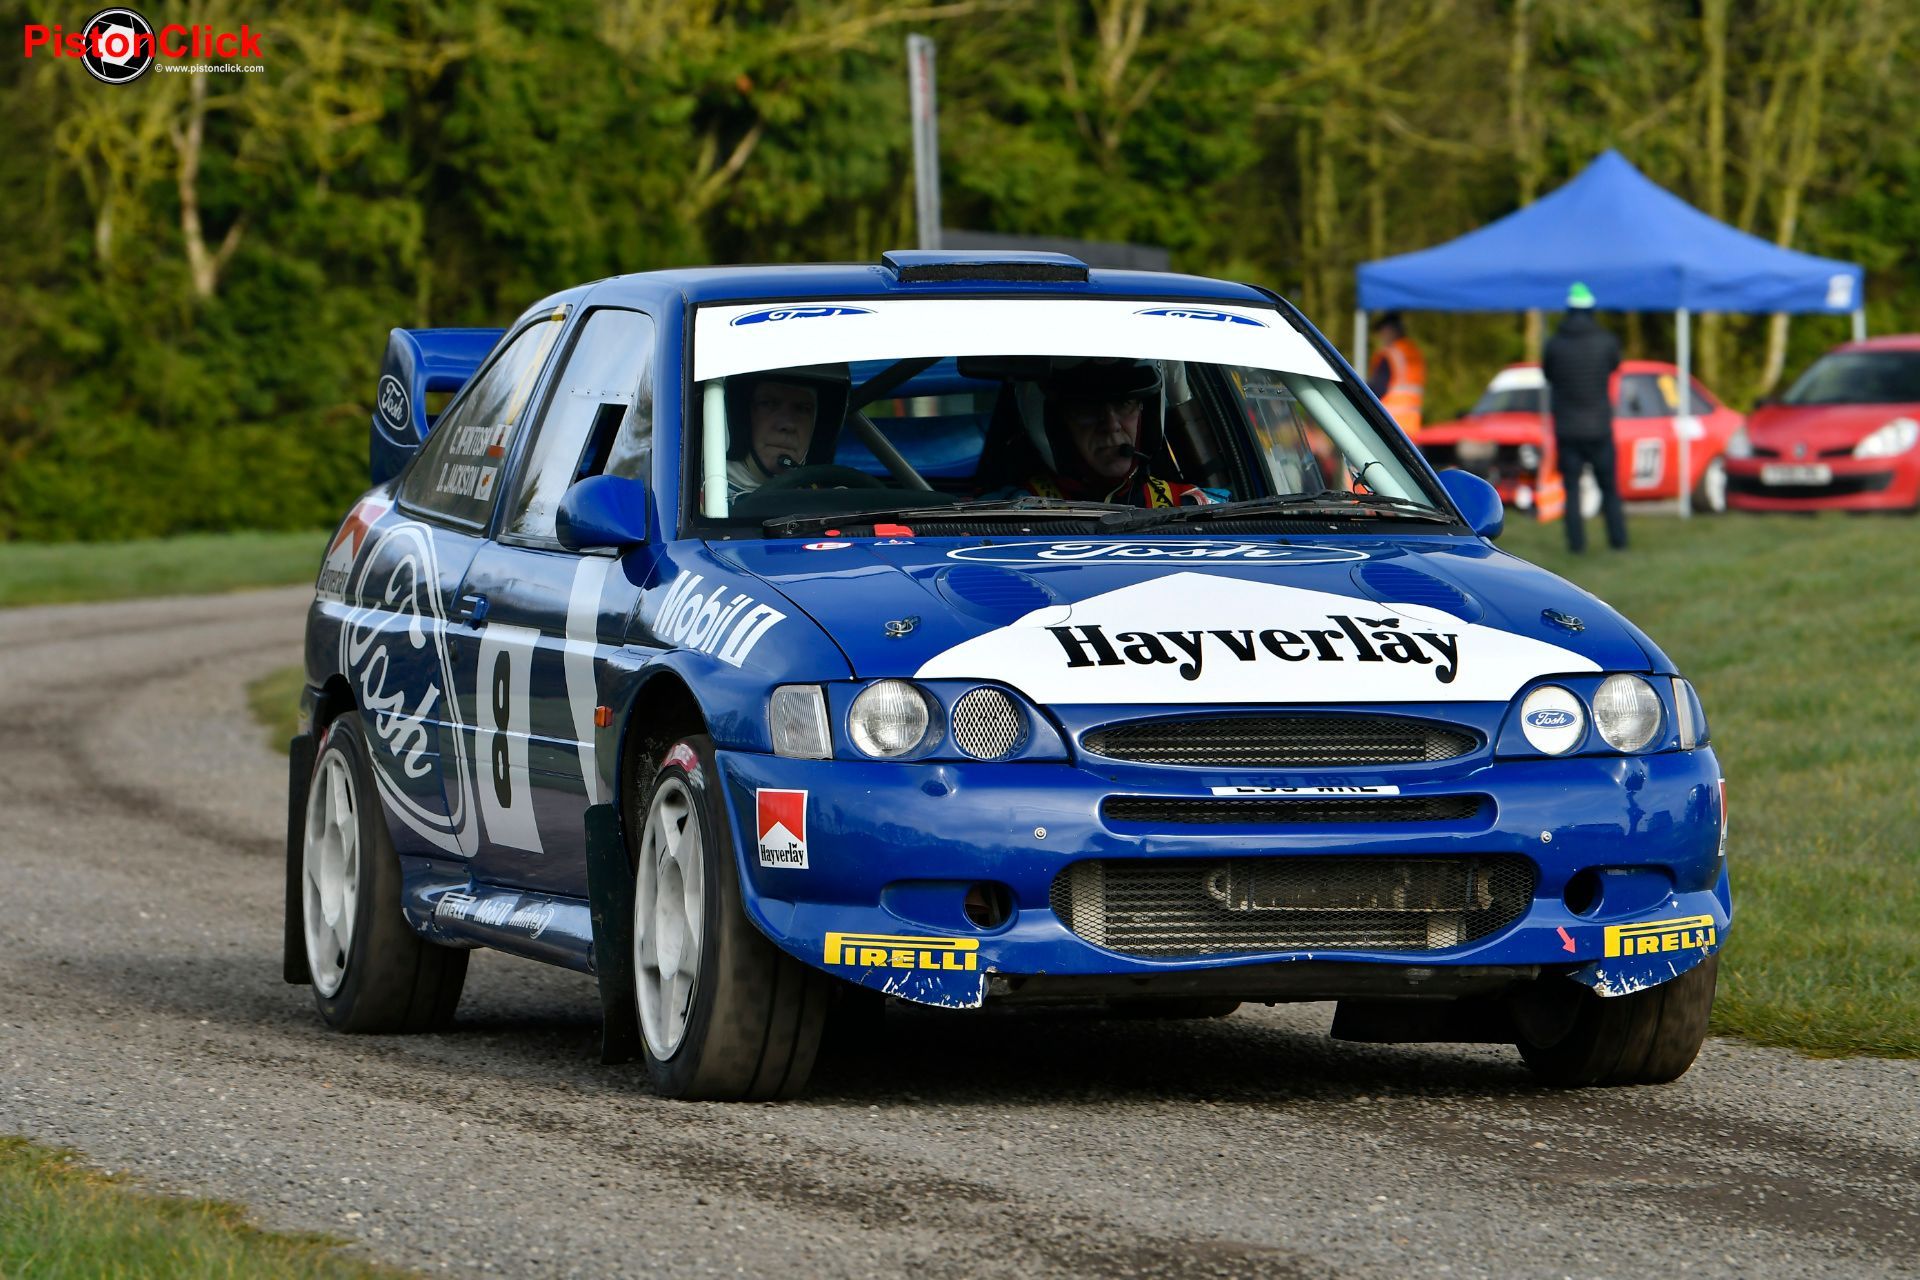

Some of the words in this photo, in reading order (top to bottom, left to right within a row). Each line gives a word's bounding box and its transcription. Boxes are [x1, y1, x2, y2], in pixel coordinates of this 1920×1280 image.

[1036, 541, 1293, 561] Tosh
[651, 569, 755, 655] Mobil
[349, 553, 440, 779] Tosh
[492, 650, 512, 808] 8
[1535, 711, 1567, 726] Tosh
[434, 891, 477, 920] PIRELLI
[823, 931, 980, 971] PIRELLI
[1603, 914, 1716, 958] PIRELLI
